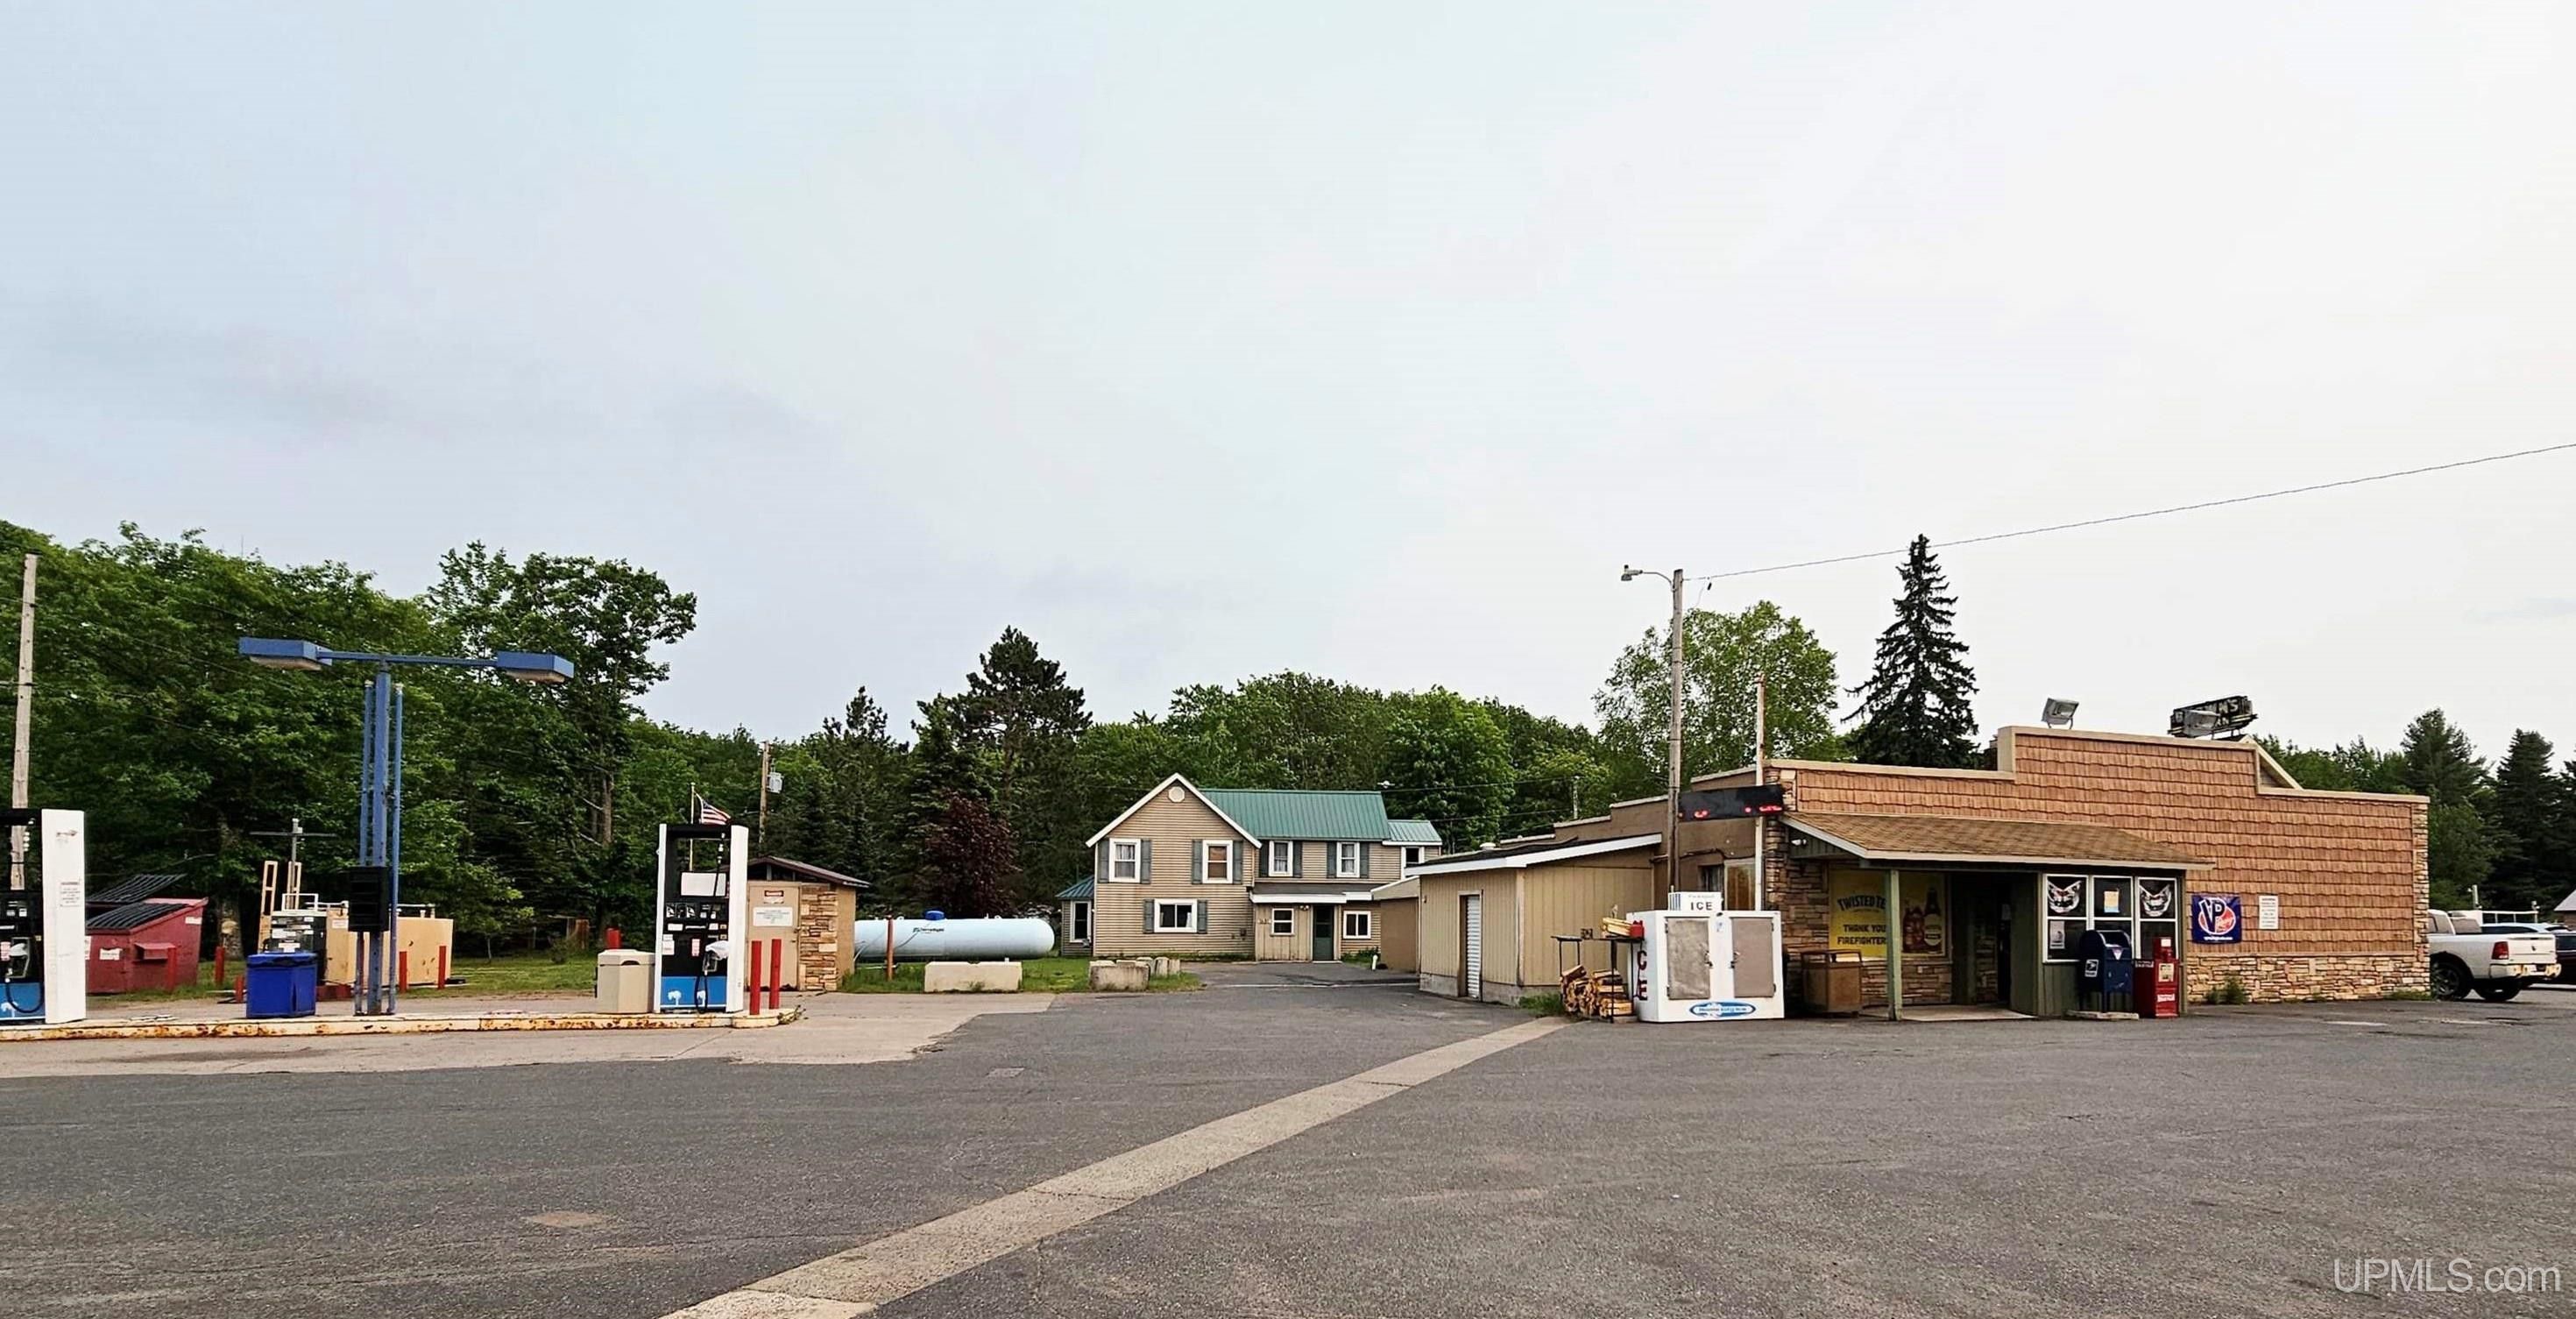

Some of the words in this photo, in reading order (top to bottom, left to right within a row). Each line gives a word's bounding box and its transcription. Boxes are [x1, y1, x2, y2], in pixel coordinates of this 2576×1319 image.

[1690, 901, 1713, 911] ICE
[1837, 895, 1875, 911] TWISTED
[1876, 895, 1886, 910] TE
[2198, 897, 2226, 935] VP
[1843, 924, 1869, 933] THANK
[1872, 924, 1886, 933] YOU
[1836, 936, 1886, 945] FIREFIGHTER
